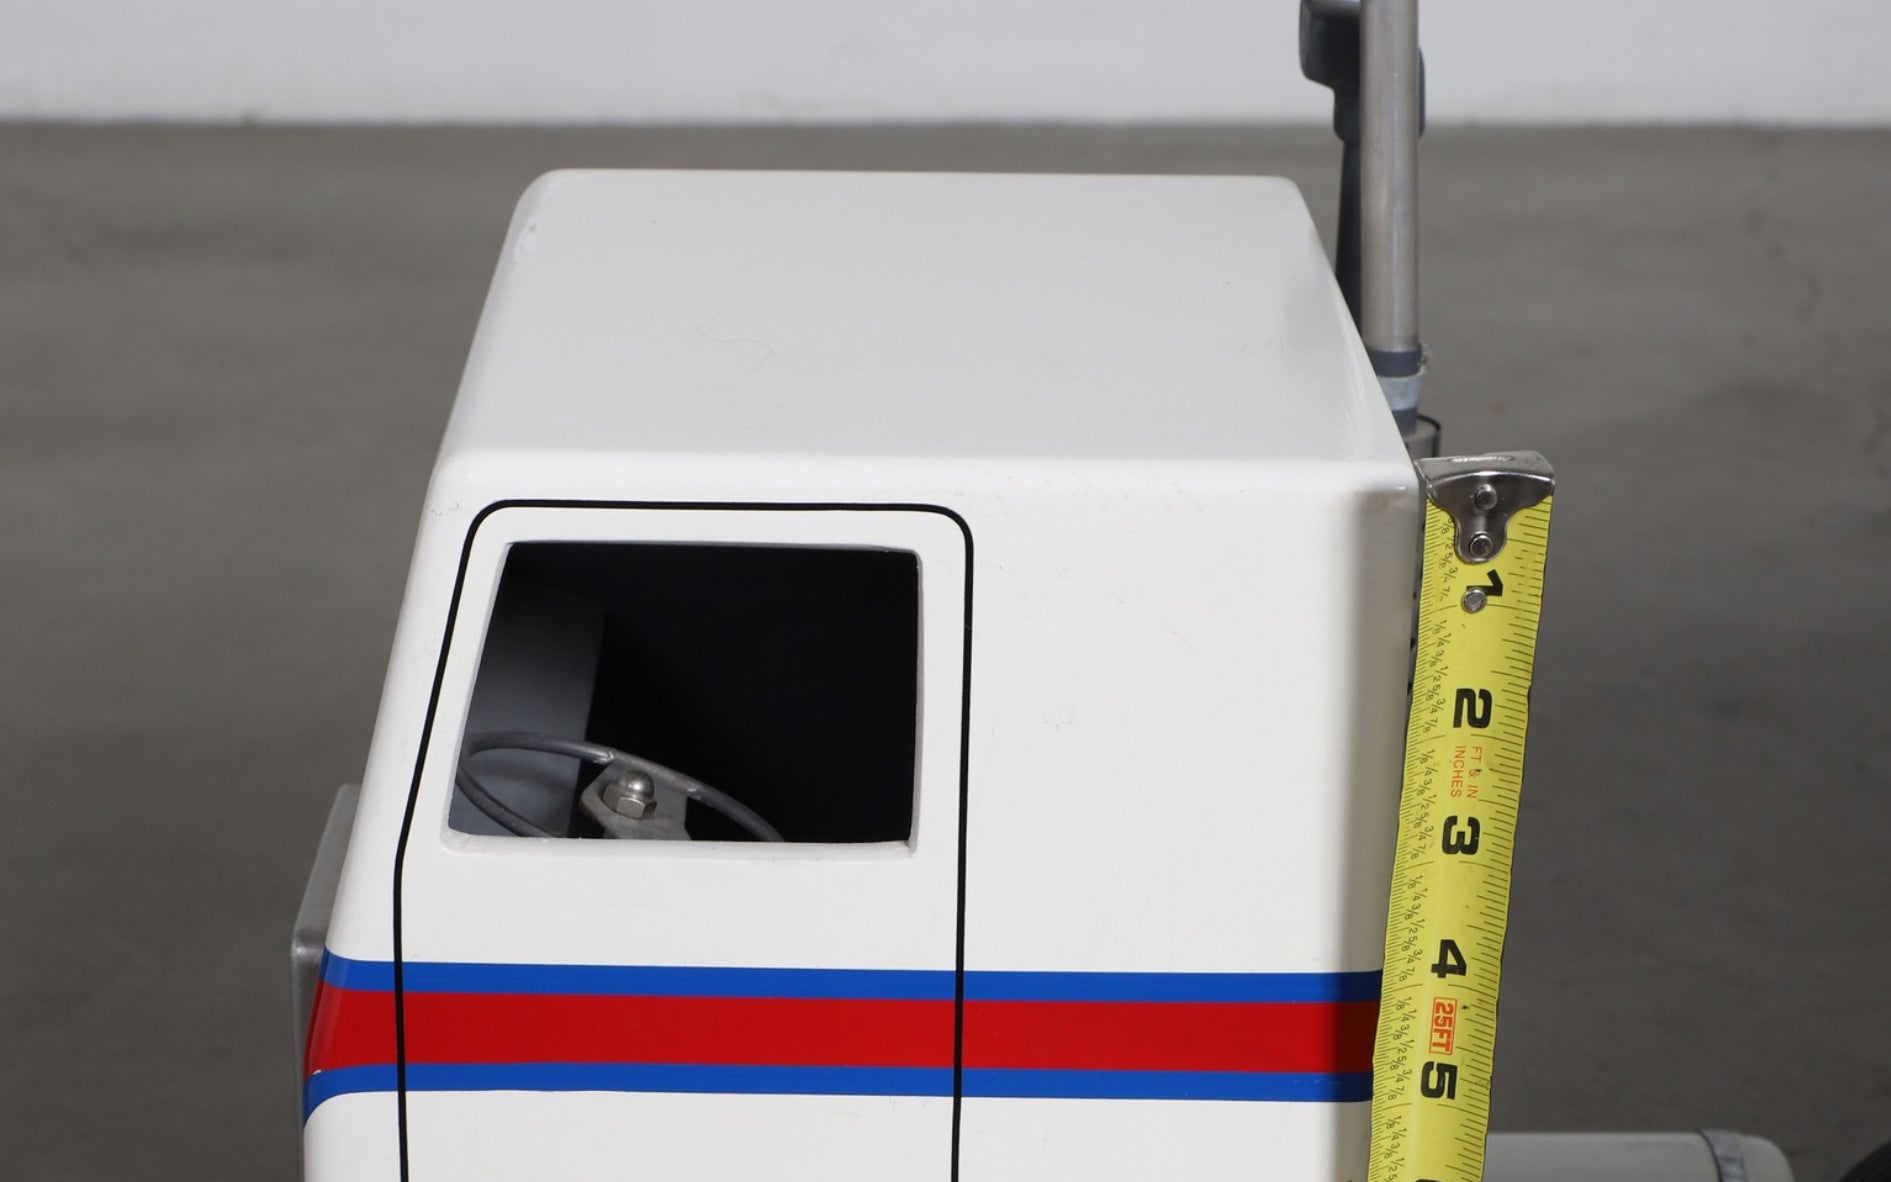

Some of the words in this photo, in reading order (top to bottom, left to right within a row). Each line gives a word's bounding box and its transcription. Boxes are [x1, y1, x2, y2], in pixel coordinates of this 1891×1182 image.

[1466, 569, 1504, 597] 1
[1453, 688, 1493, 729] 2
[1450, 746, 1466, 798] INCHES
[1468, 768, 1480, 778] &
[1470, 746, 1483, 763] FT
[1466, 785, 1480, 799] IN
[1441, 815, 1481, 855] 3
[1430, 938, 1467, 979] 4
[1431, 999, 1456, 1053] 25FT
[1420, 1060, 1458, 1100] 5
